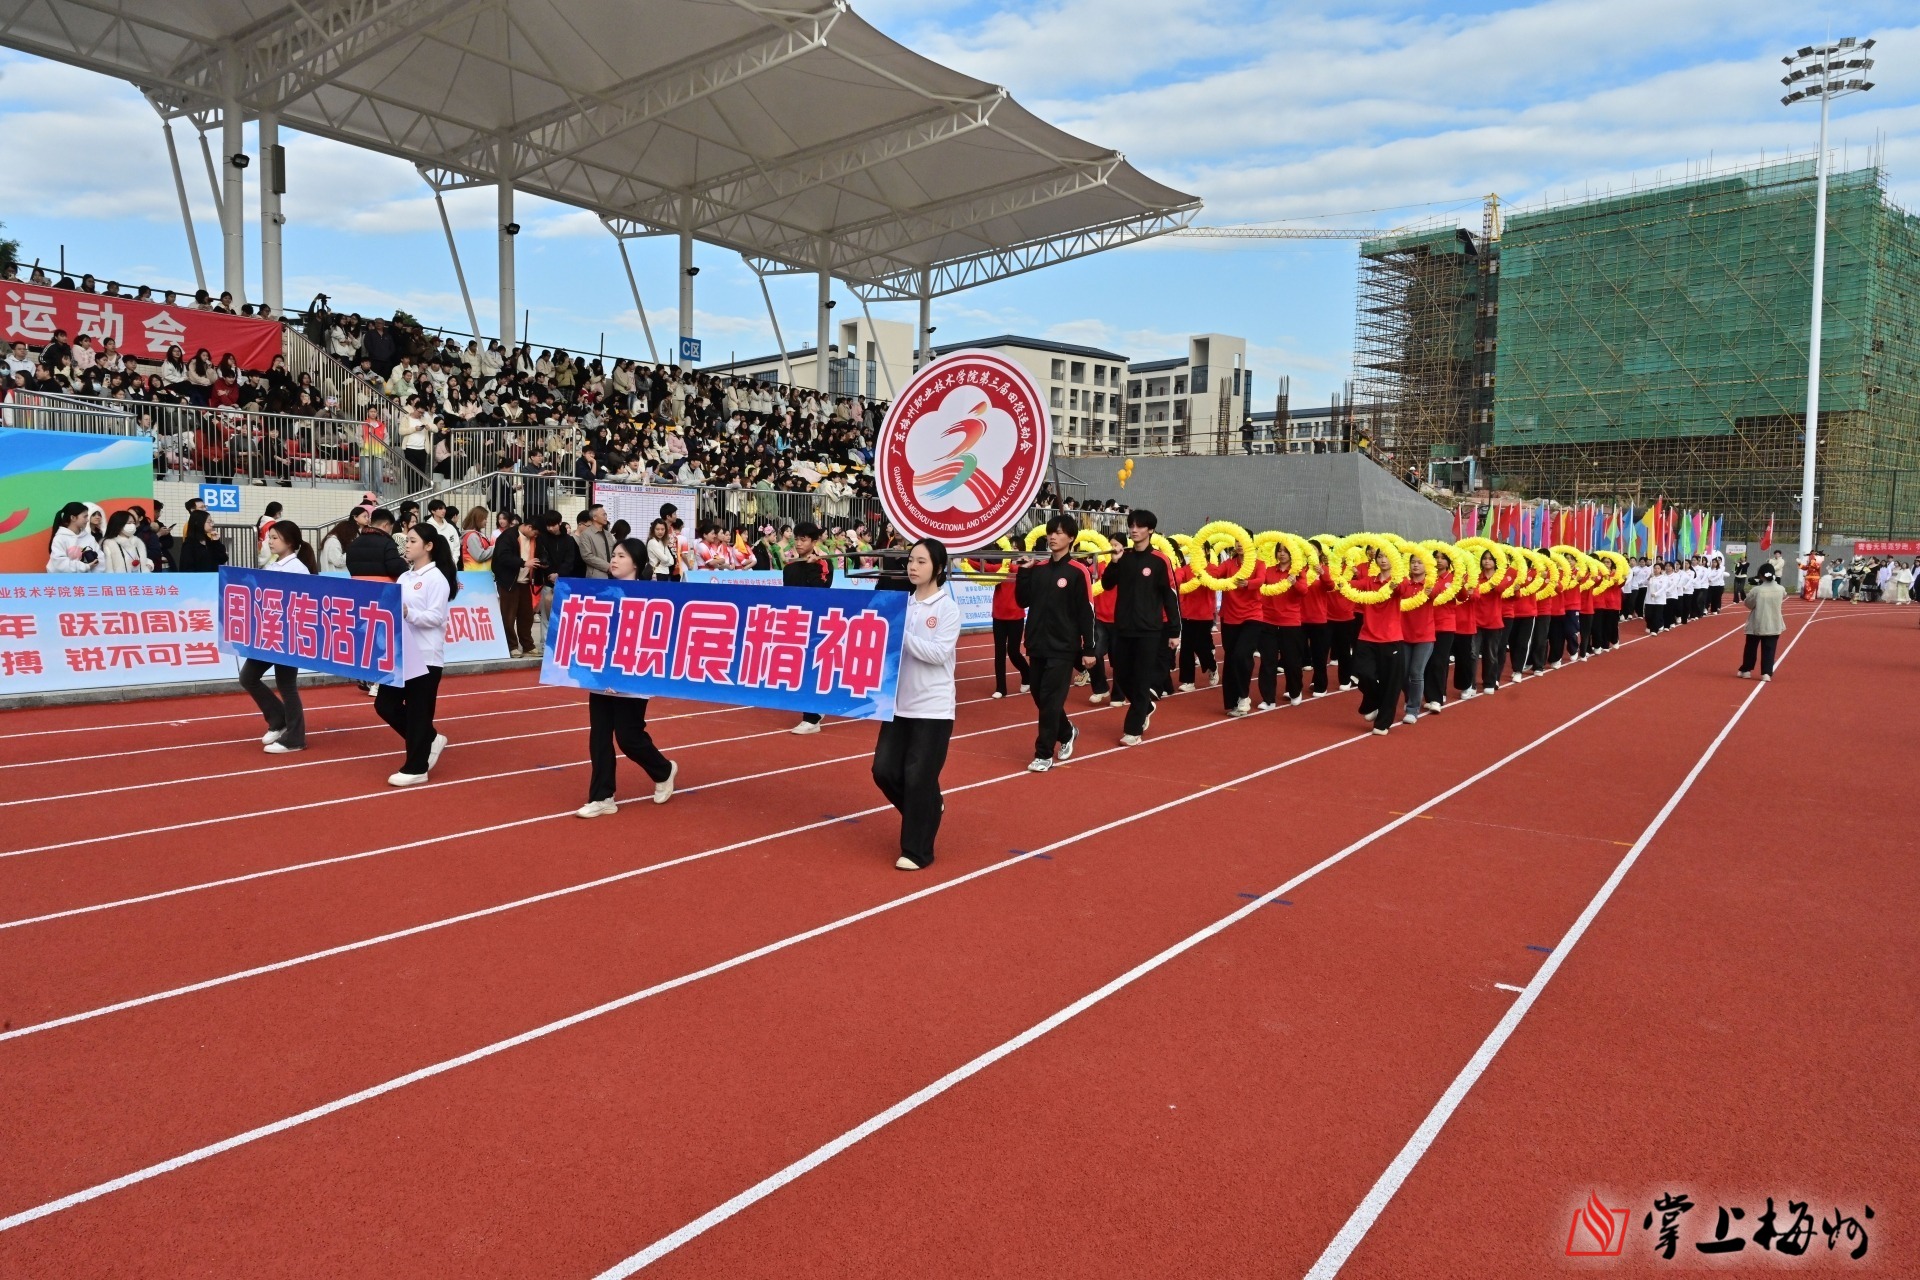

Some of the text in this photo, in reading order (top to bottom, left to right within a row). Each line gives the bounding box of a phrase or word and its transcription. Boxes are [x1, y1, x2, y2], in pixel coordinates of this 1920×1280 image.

[5, 290, 187, 355] 运动会
[682, 341, 700, 358] C区
[890, 369, 1033, 457] 广东梅州职业技术学院第三届田径运动会
[203, 488, 237, 508] B区
[893, 466, 1026, 532] GUANGDONG MEIZHOU VOCATIONAL AND TECHNICAL COLLEGE
[0, 585, 180, 598] 业技术学院第三届田径运动会
[0, 609, 214, 639] 年 跃动周溪
[223, 583, 395, 673] 周溪传活力
[553, 593, 890, 698] 梅职展精神
[1, 642, 220, 676] 搏 锐不可当
